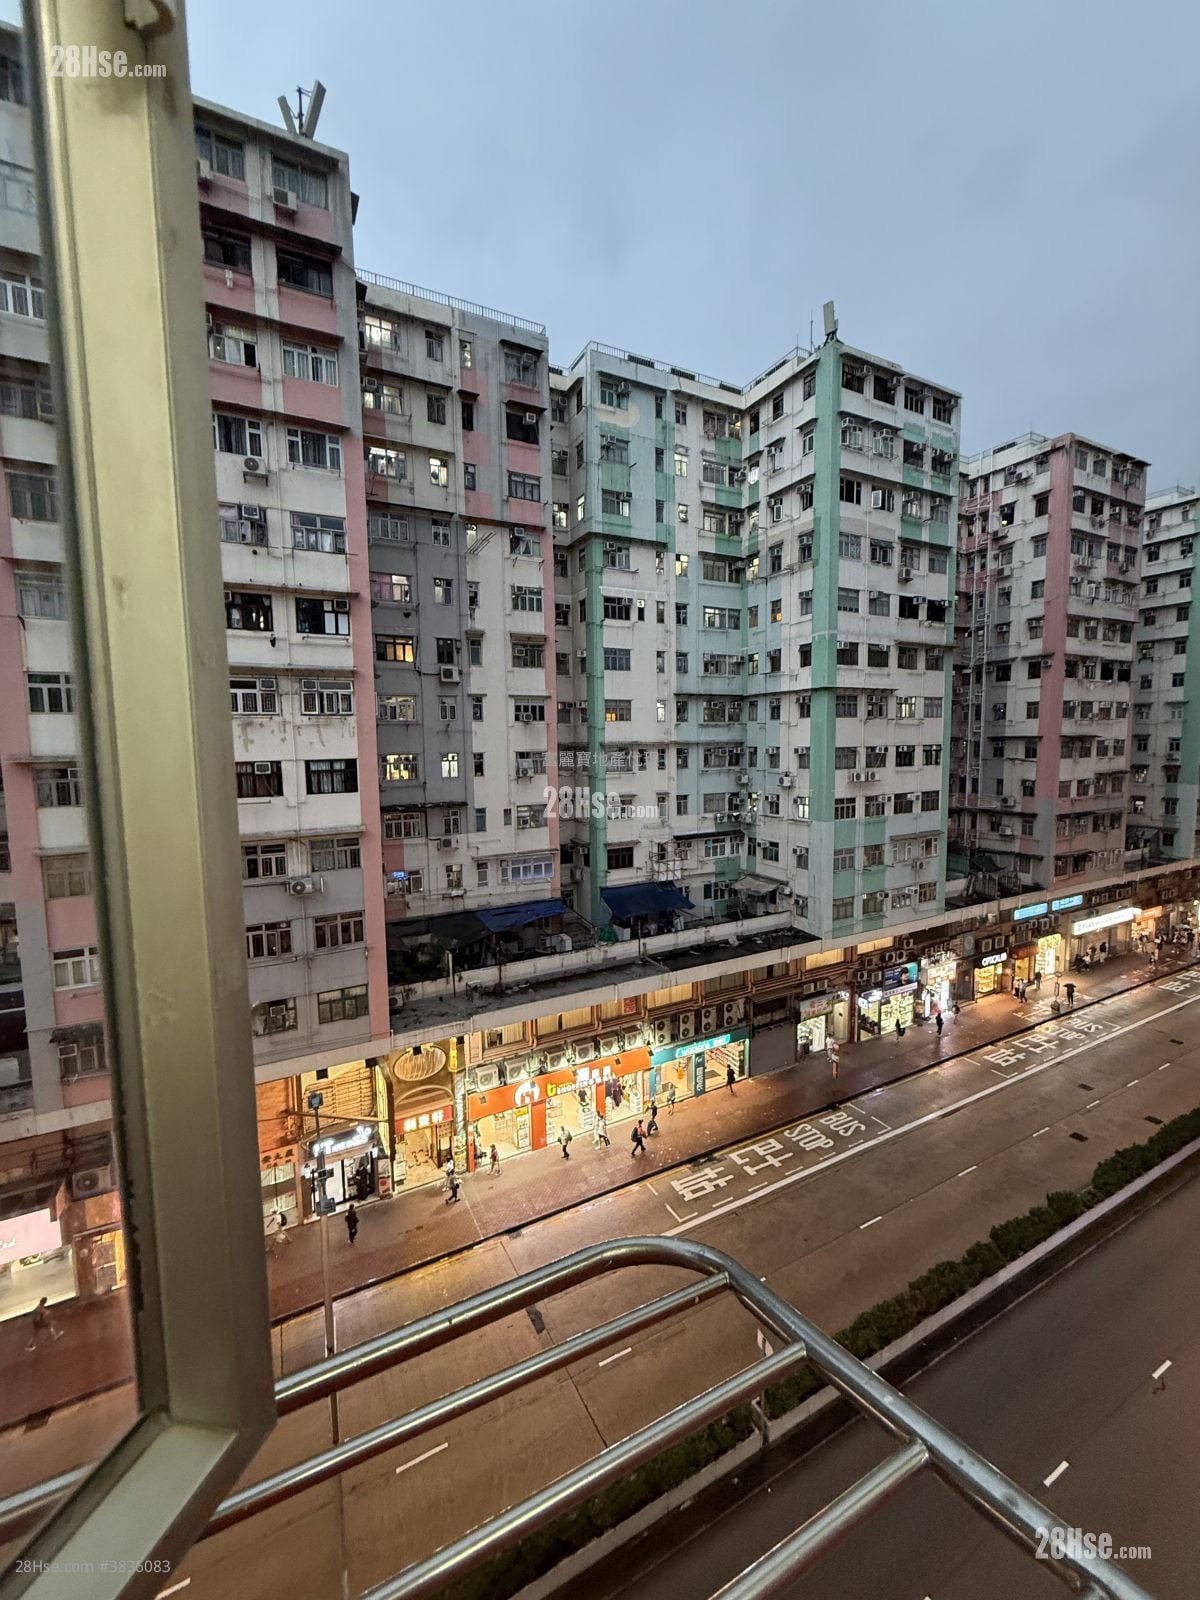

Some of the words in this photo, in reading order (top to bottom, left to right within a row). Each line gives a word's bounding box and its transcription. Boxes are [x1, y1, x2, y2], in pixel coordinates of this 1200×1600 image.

[1043, 1024, 1086, 1041] STOP
[1066, 1018, 1103, 1033] BUS
[983, 1047, 1027, 1067] 站
[784, 1123, 834, 1151] STOP
[819, 1112, 866, 1137] BUS
[729, 1138, 794, 1176] 巴士
[670, 1166, 734, 1202] 站
